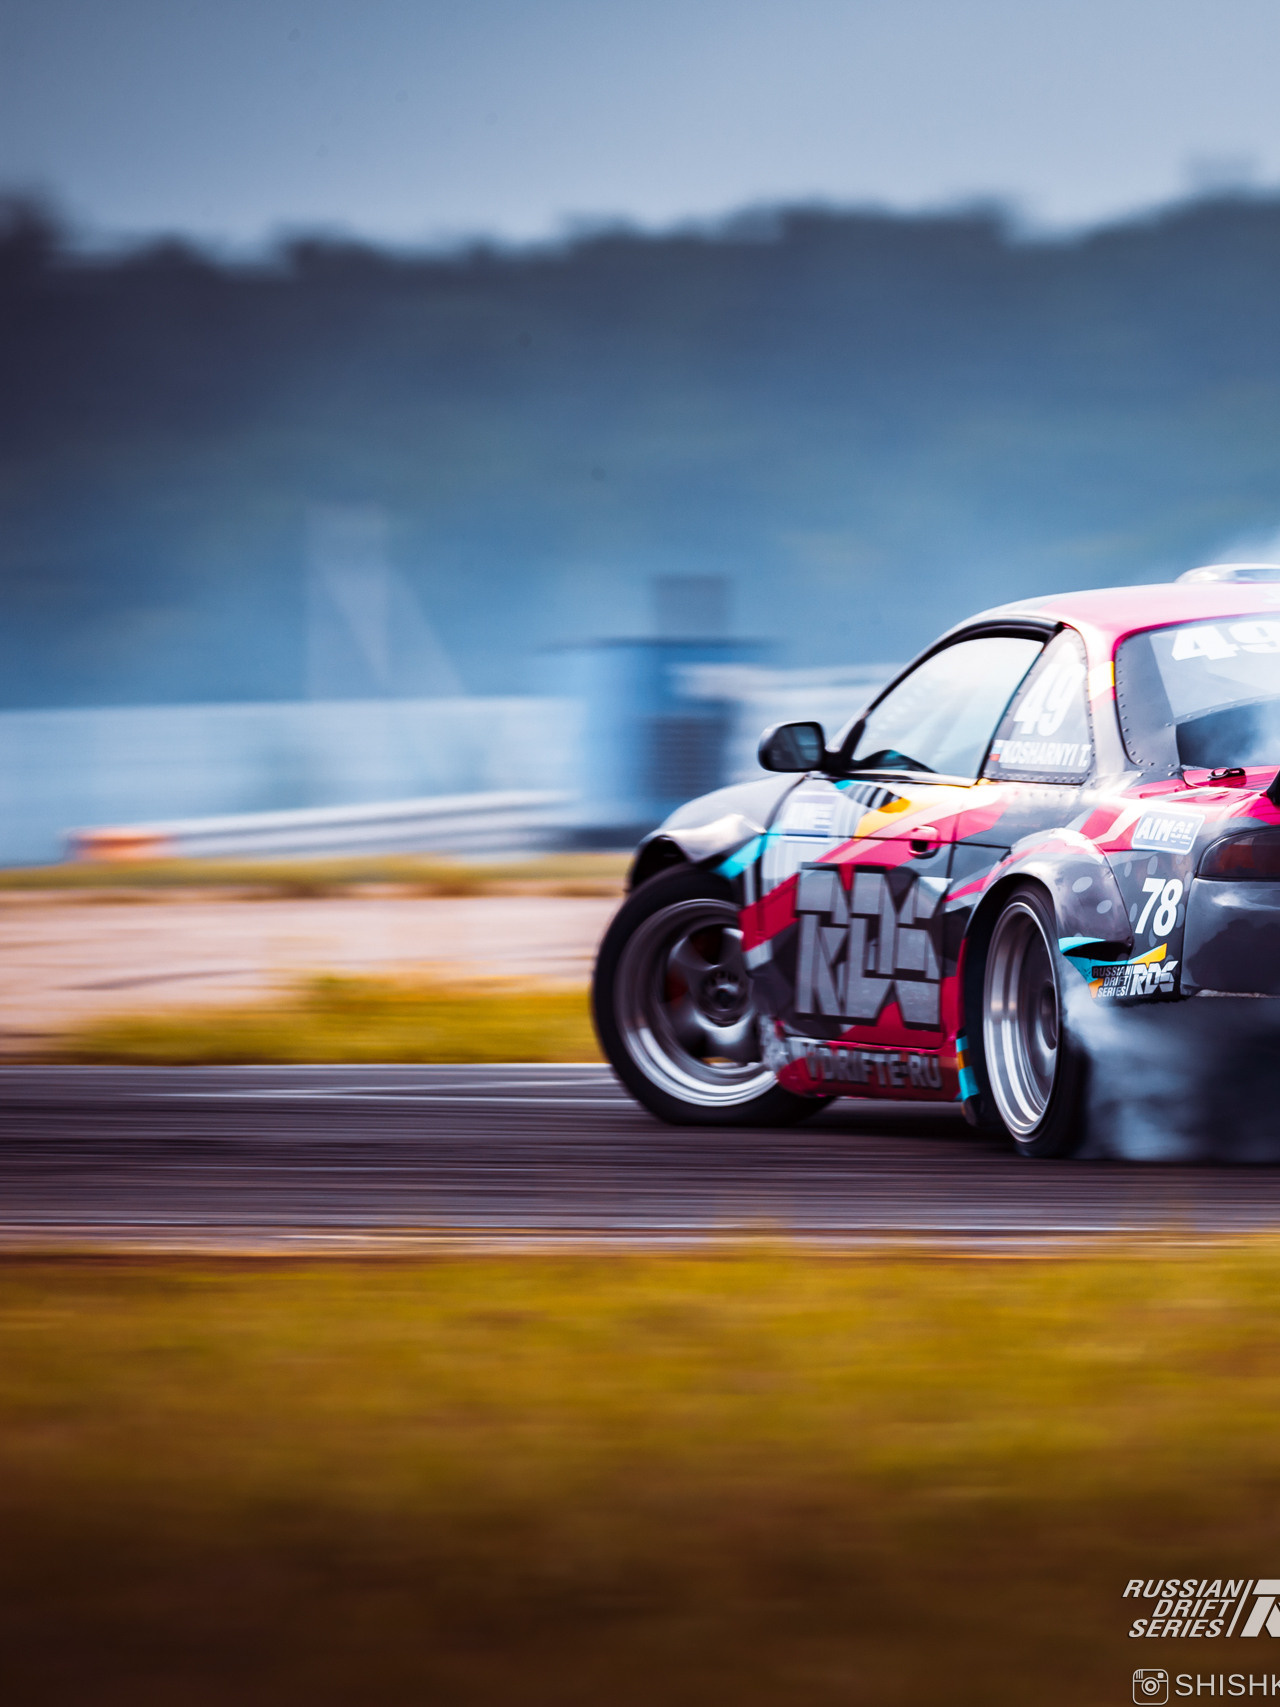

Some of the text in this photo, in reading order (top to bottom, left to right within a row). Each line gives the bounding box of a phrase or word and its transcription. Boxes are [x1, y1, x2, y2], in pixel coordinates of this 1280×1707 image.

[1013, 664, 1086, 736] 49
[1135, 878, 1183, 937] 78
[1093, 964, 1131, 977] RUSSIAN
[1103, 975, 1129, 987] DRIFT
[1130, 960, 1179, 996] RDS
[1097, 985, 1127, 998] SERIES
